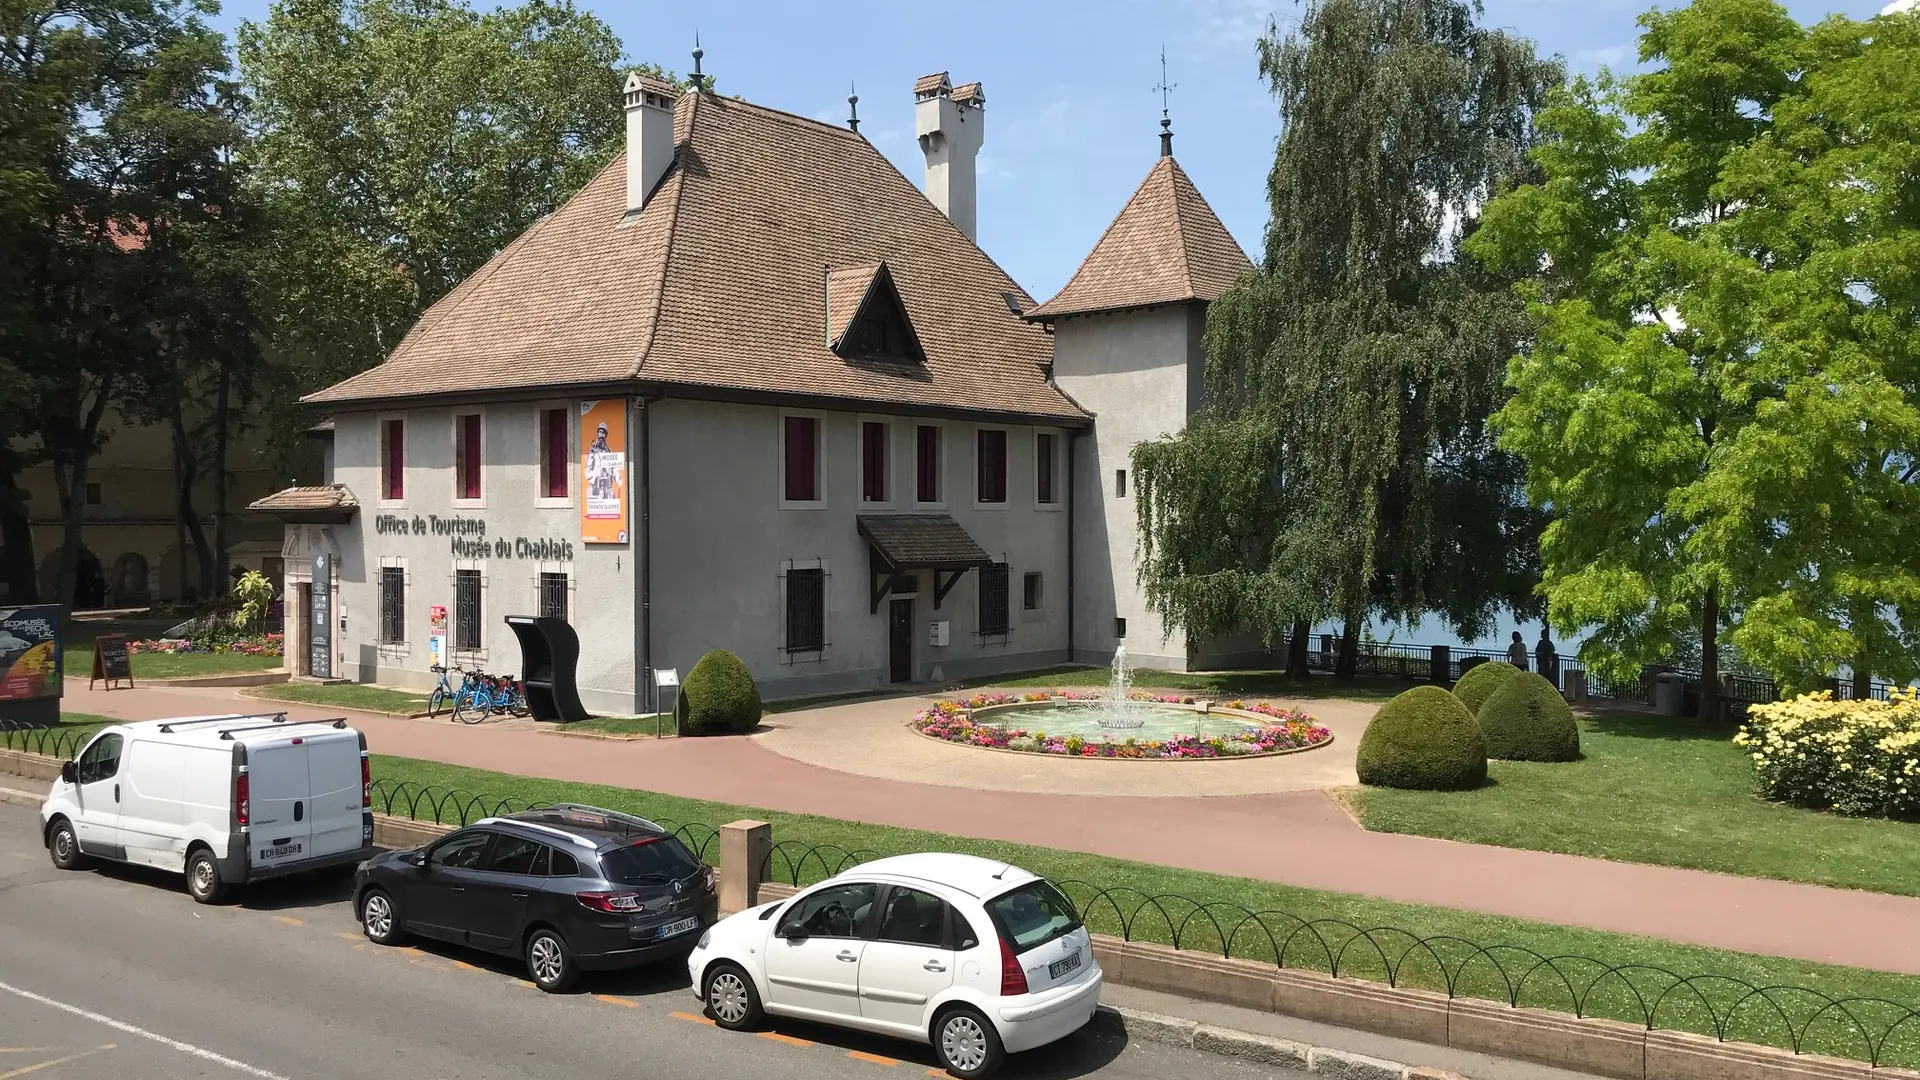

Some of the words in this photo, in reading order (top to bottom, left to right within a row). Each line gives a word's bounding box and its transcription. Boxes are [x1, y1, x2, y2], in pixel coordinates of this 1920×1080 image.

[375, 514, 409, 535] Office
[411, 515, 427, 535] de
[428, 514, 486, 536] Tourisme
[451, 536, 492, 558] Musée
[495, 536, 512, 559] du
[515, 536, 574, 561] Chablais
[4, 618, 46, 628] ÉCOMUSÉE
[38, 630, 54, 638] LAC
